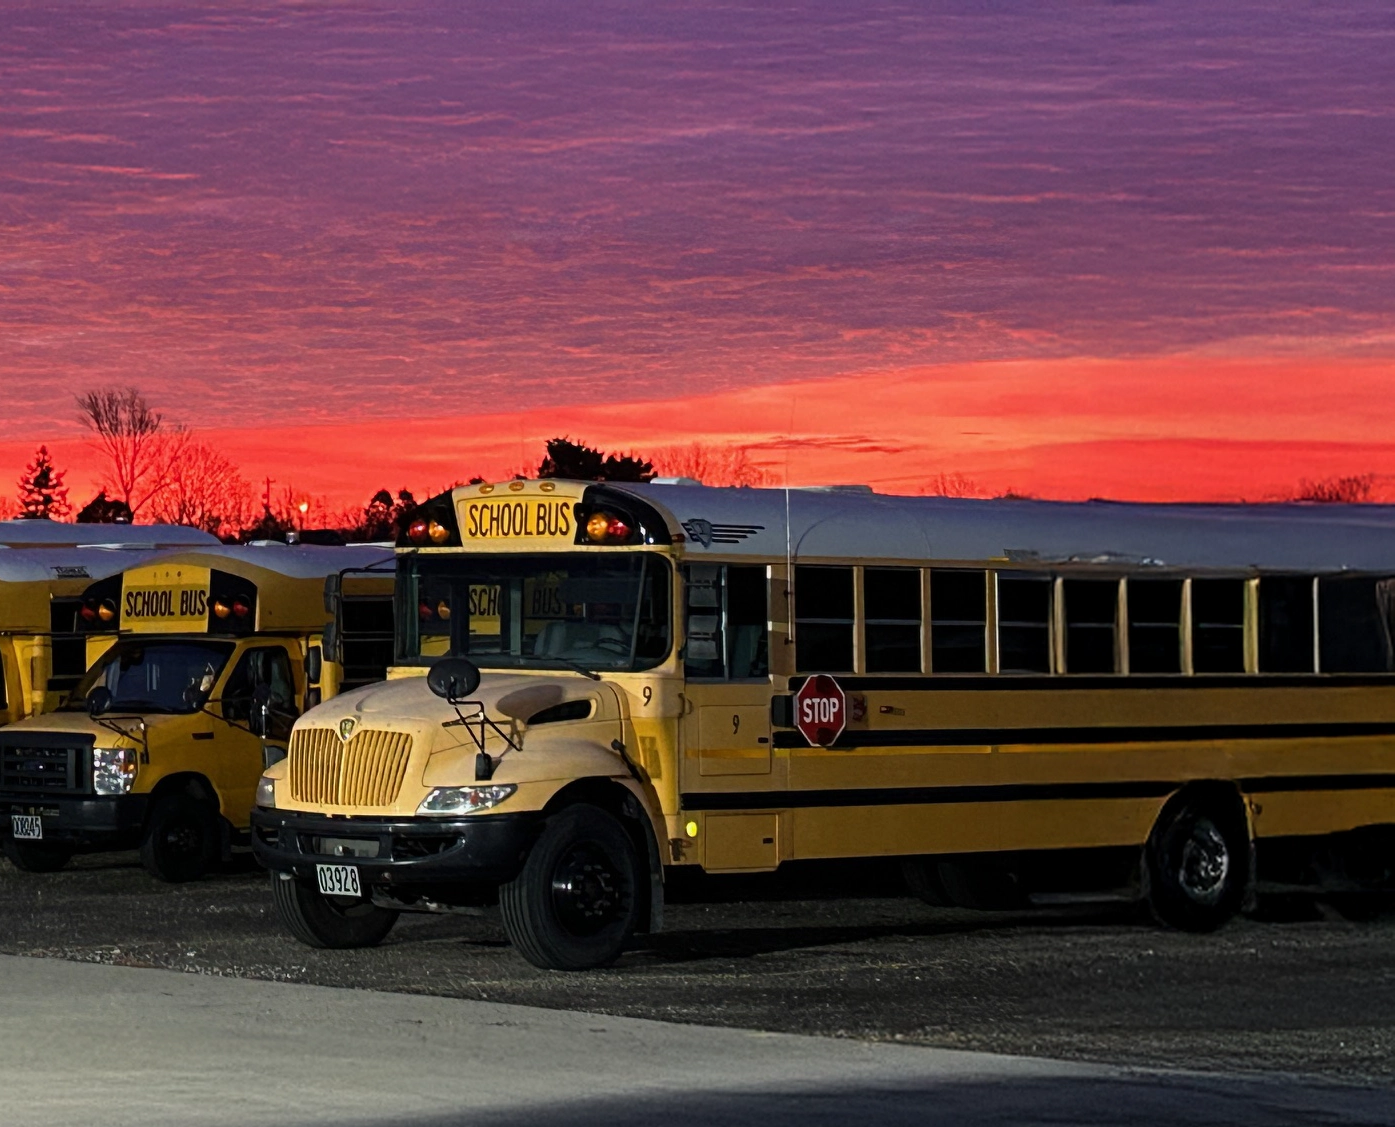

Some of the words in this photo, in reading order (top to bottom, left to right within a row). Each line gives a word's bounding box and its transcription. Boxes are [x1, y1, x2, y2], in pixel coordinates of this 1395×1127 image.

[468, 502, 533, 537] SCHOOL
[536, 502, 570, 536] BUS
[125, 590, 175, 617] SCHOOL
[180, 589, 206, 616] BUS
[532, 586, 562, 615] BUS
[642, 685, 652, 707] 9
[732, 714, 740, 735] 9
[803, 697, 839, 724] STOP
[318, 866, 359, 894] 03928
